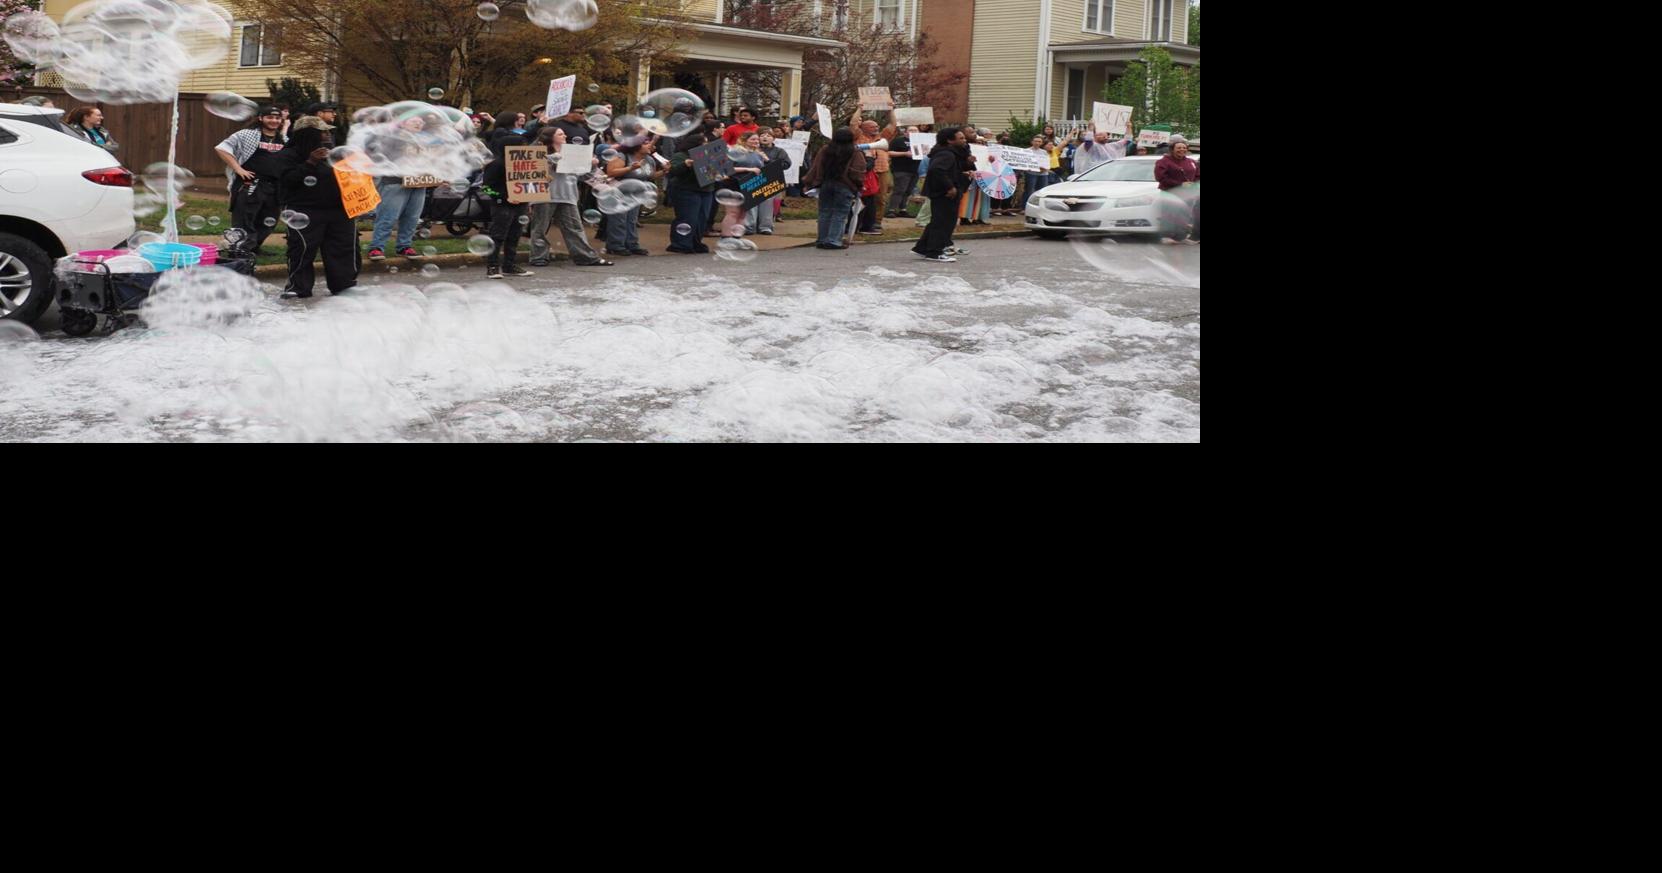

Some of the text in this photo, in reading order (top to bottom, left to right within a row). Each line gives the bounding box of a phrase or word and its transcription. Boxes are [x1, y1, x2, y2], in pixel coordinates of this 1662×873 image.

[509, 150, 548, 161] TAKE UR
[513, 161, 538, 171] HATE
[508, 170, 547, 181] LEAVE OUR
[751, 180, 780, 198] POLITICAL
[996, 190, 1006, 199] TO
